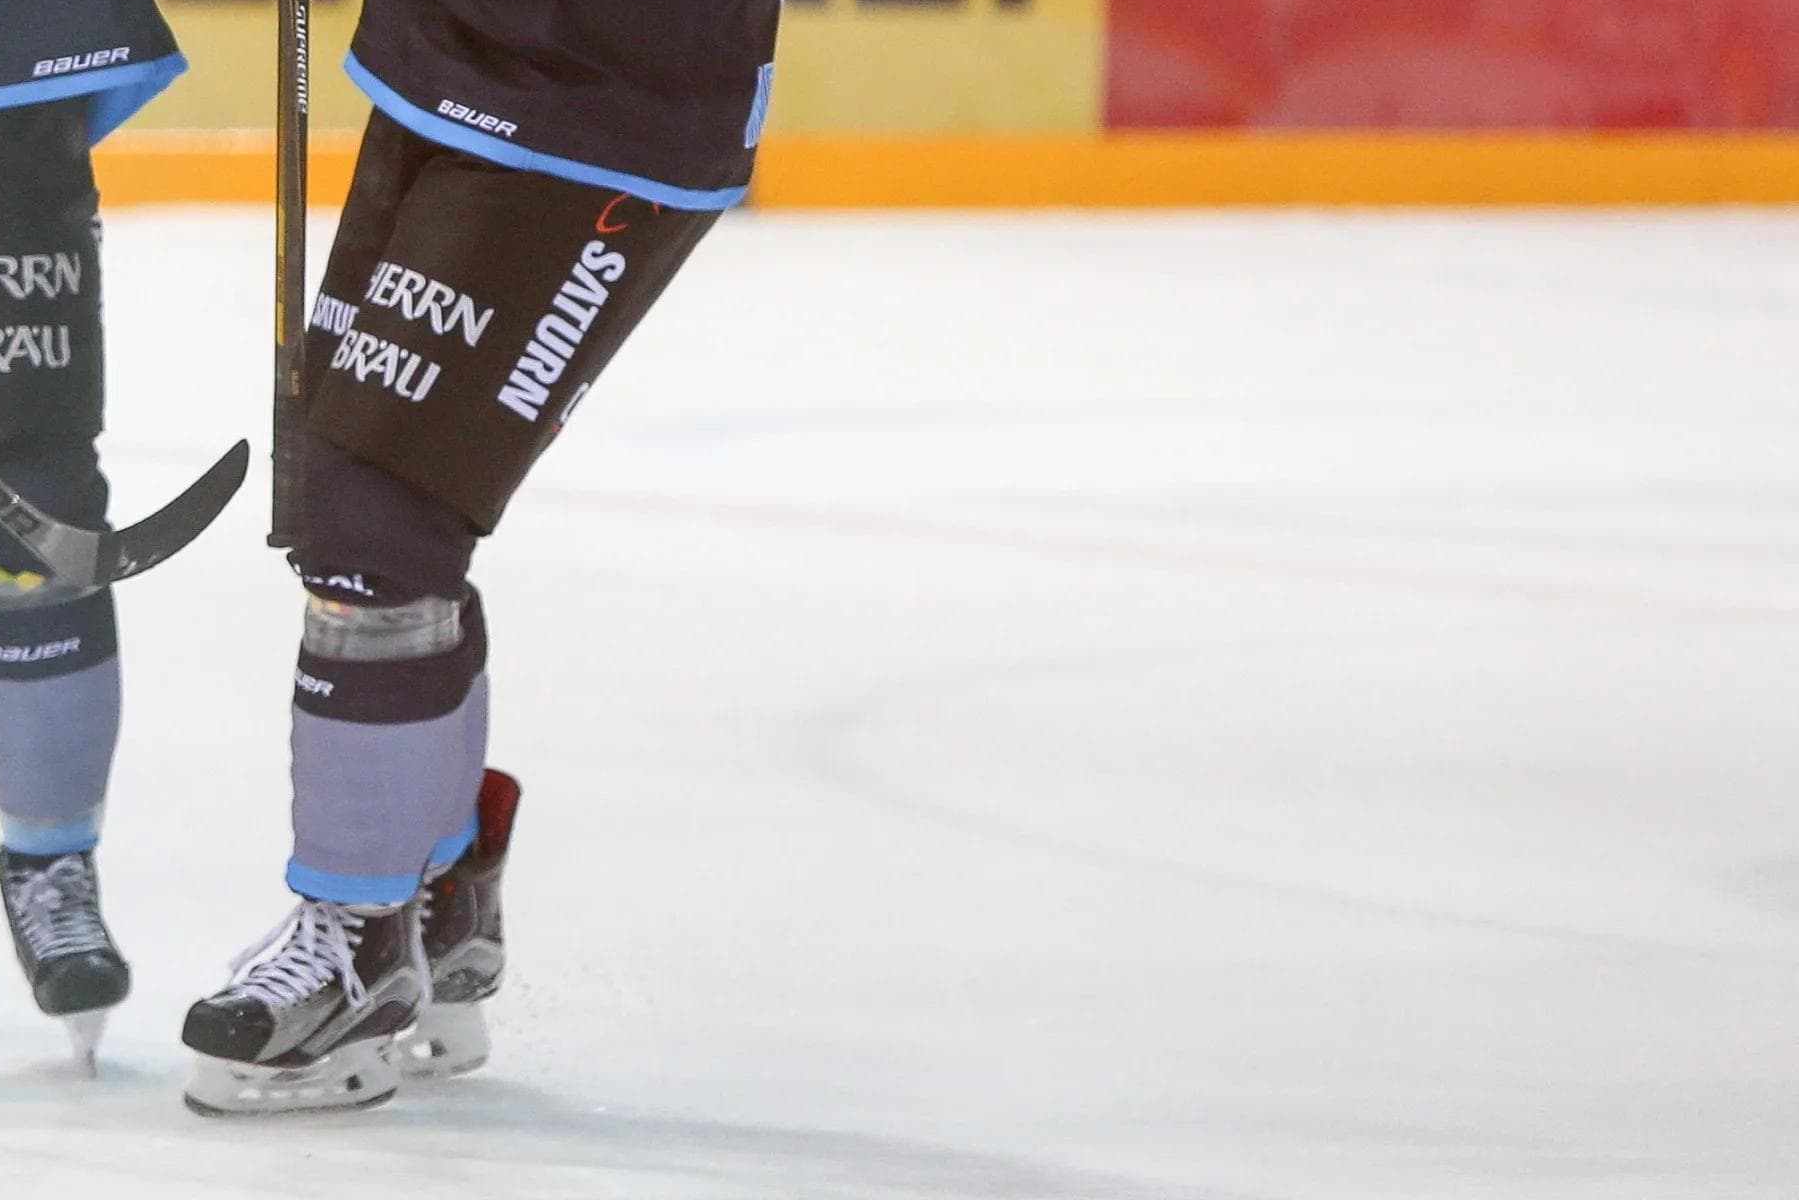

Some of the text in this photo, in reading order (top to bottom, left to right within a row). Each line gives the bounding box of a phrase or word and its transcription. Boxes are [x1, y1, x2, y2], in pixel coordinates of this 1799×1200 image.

[32, 45, 131, 78] BAUER
[438, 98, 519, 138] BAUER
[497, 239, 627, 423] SATURN
[330, 327, 442, 402] BRÄU
